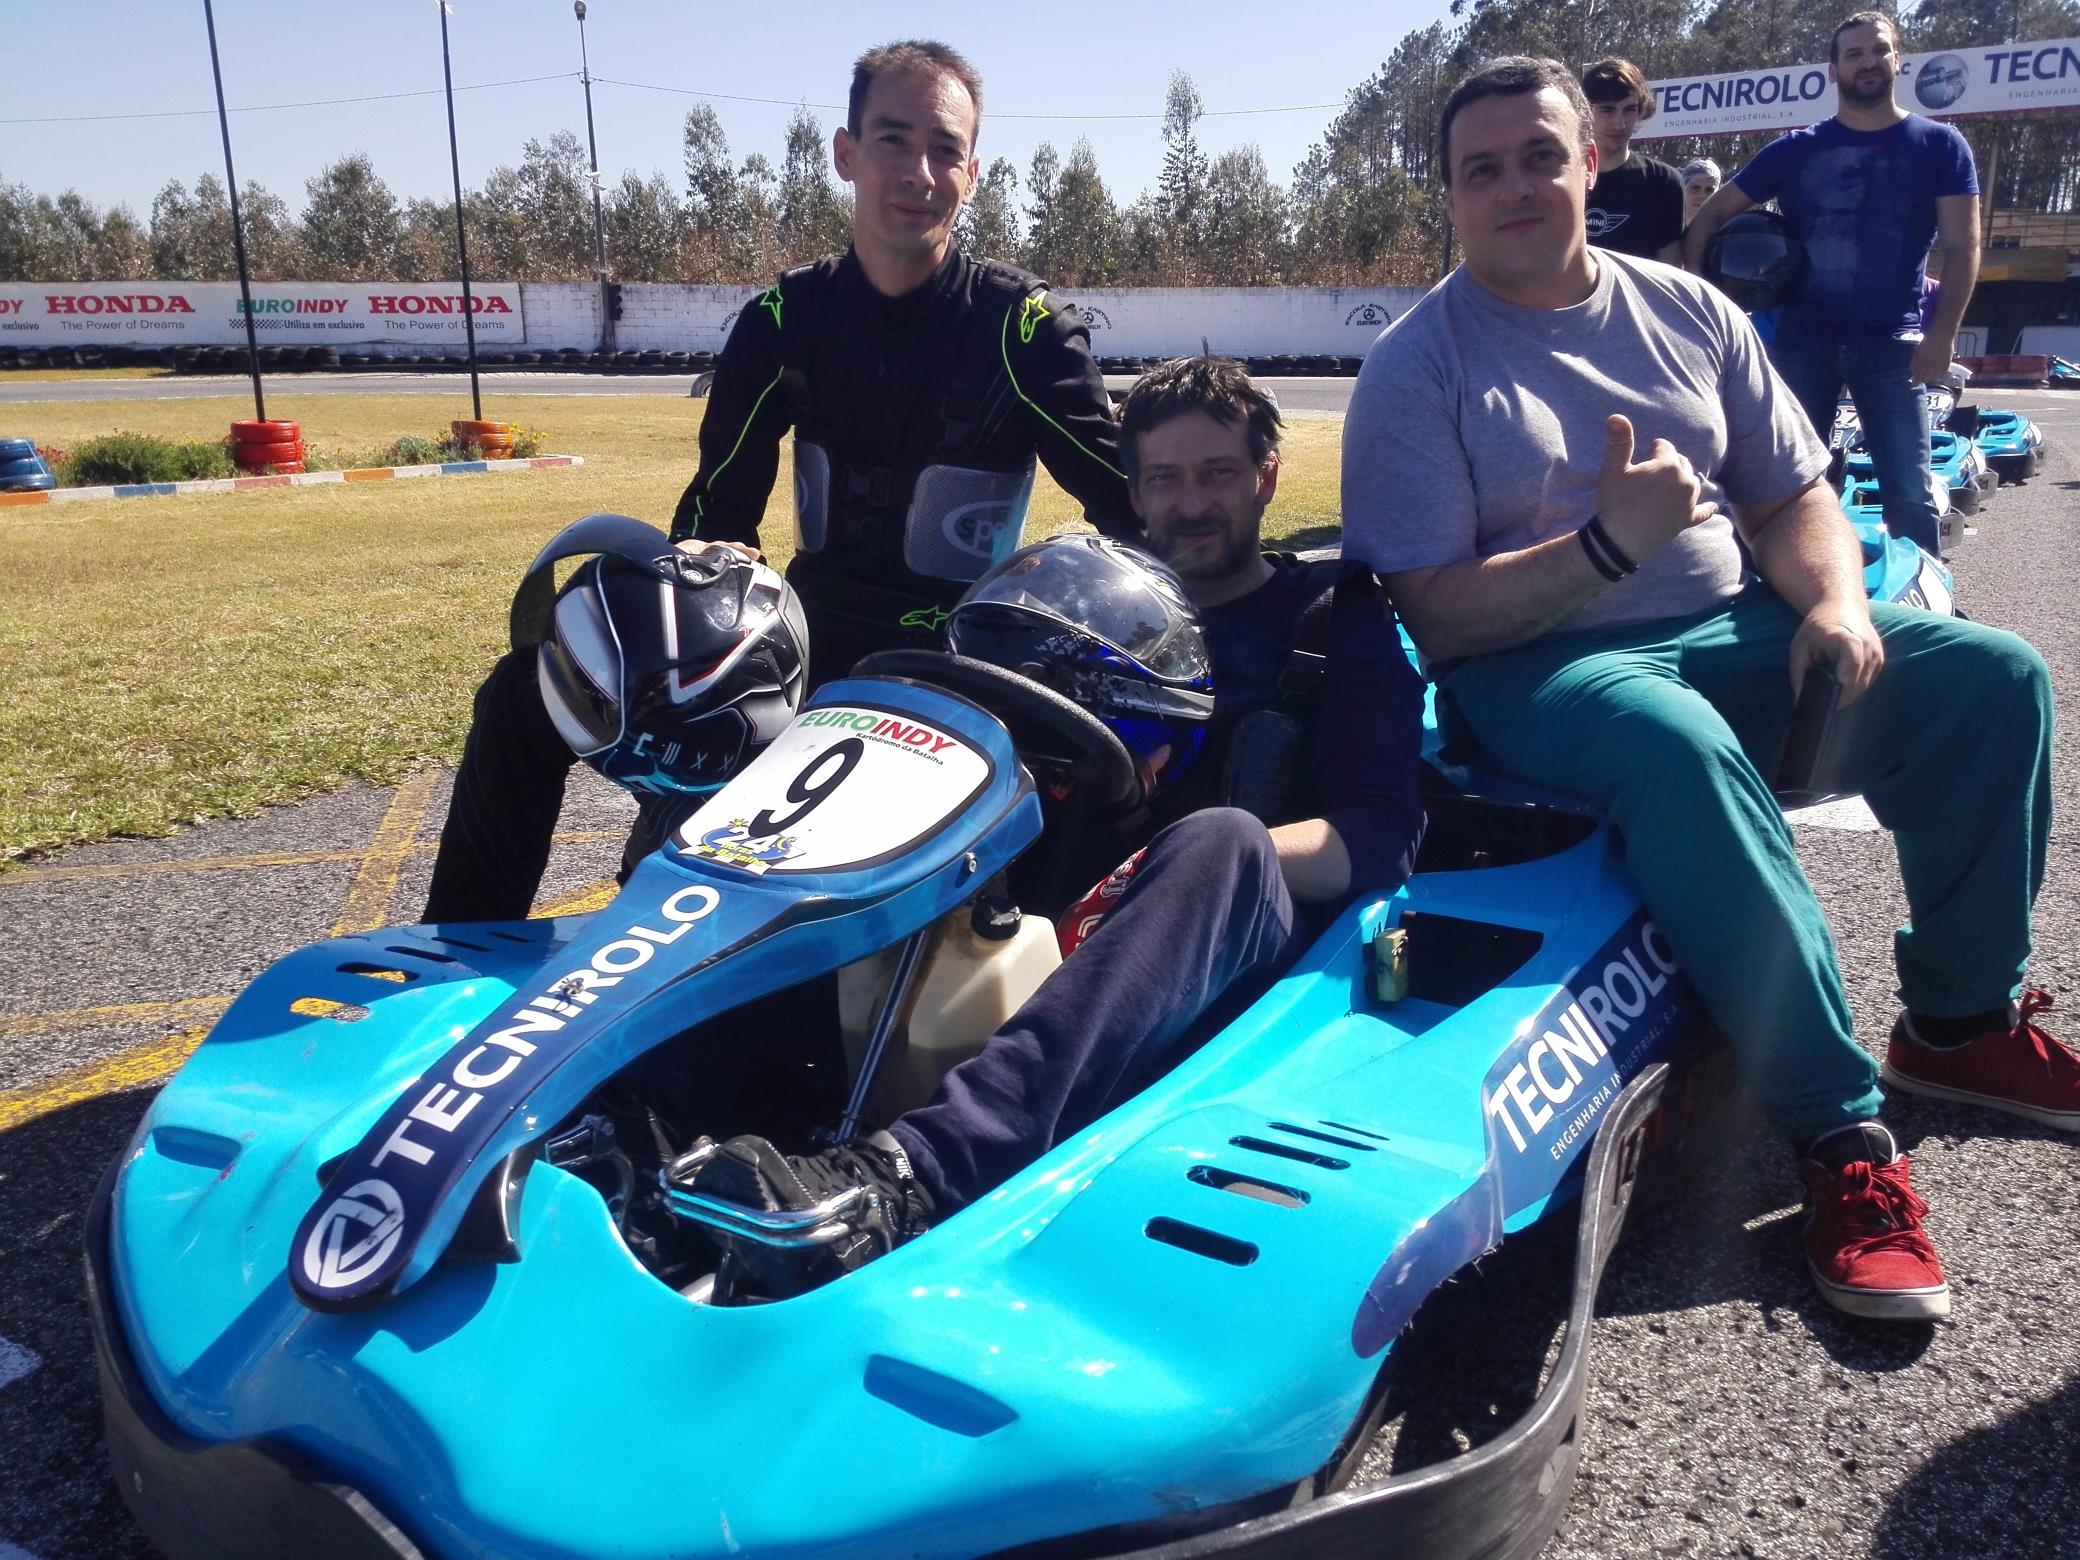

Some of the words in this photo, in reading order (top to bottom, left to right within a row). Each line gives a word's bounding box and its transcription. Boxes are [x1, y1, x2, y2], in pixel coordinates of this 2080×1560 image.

[2008, 87, 2078, 100] ENGENHARIA
[1664, 116, 1717, 128] ENGENHARIA
[1585, 218, 1605, 227] MINI
[44, 295, 196, 315] HONDA
[235, 298, 349, 314] EUROINDY
[367, 295, 513, 315] HONDA
[1344, 303, 1366, 326] ESCOLA
[2, 320, 40, 331] exclusivo
[61, 320, 82, 331] The
[85, 320, 122, 331] Power
[126, 319, 137, 330] of
[140, 319, 185, 330] Dreams
[284, 319, 311, 330] Utiliza
[312, 322, 326, 330] em
[327, 319, 366, 330] exclusivo
[384, 320, 406, 330] The
[409, 320, 445, 330] Power
[447, 319, 459, 330] of
[720, 311, 740, 332] ESCOL
[798, 711, 957, 754] EUROINDY
[855, 731, 901, 748] Kartódromo
[901, 743, 912, 752] da
[912, 748, 944, 766] Batalha
[747, 737, 865, 838] 9
[710, 825, 781, 854] 24
[370, 883, 721, 1167] TECNIROLO
[1550, 1085, 1612, 1161] ENGENHARIA
[895, 1157, 912, 1179] NIK
